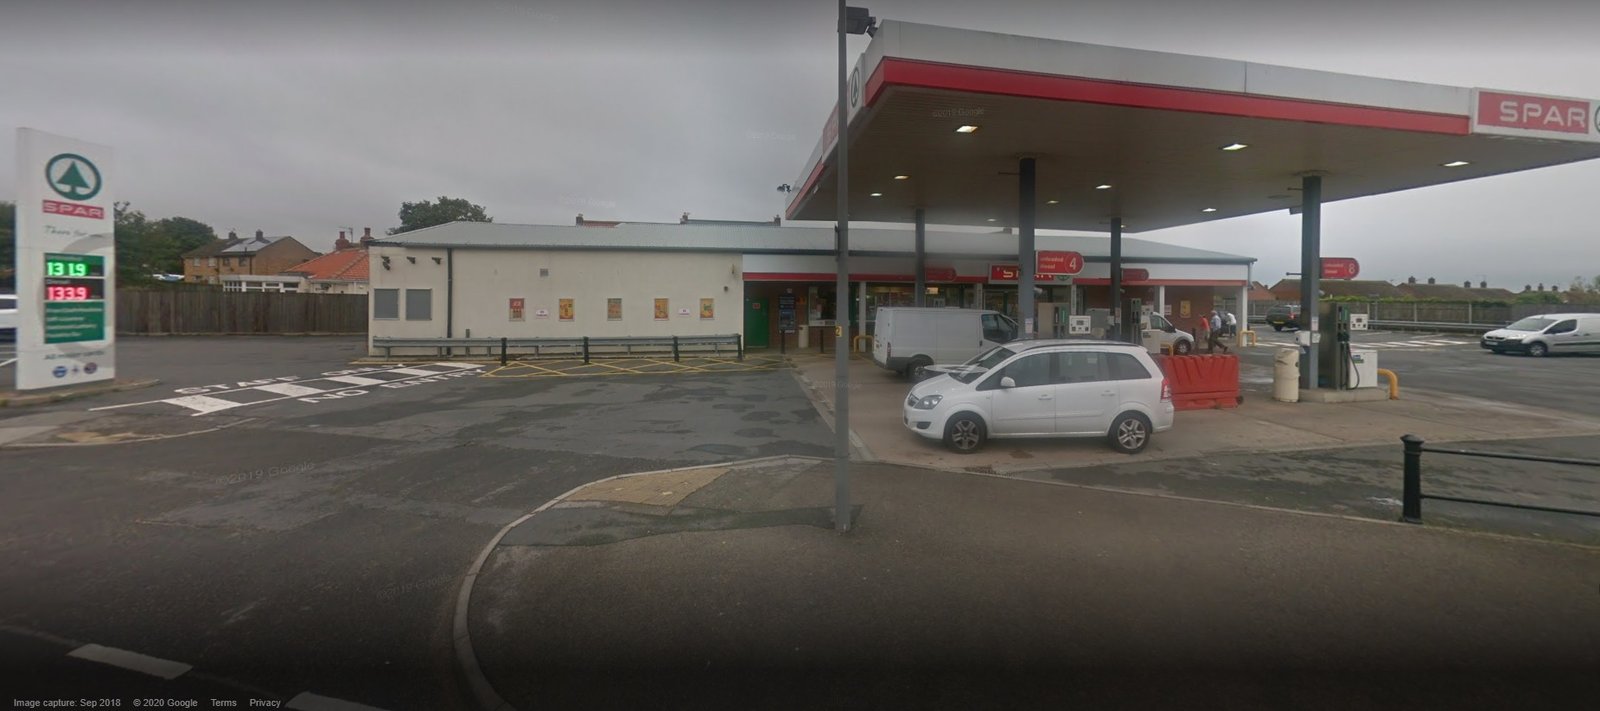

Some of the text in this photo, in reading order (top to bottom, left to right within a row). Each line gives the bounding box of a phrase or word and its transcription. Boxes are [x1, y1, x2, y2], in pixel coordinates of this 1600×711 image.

[1499, 101, 1586, 128] SPAR
[44, 201, 103, 218] SPAR
[1070, 257, 1077, 270] 4
[1349, 262, 1356, 275] 8
[173, 375, 301, 394] STAFF
[297, 389, 370, 403] NO
